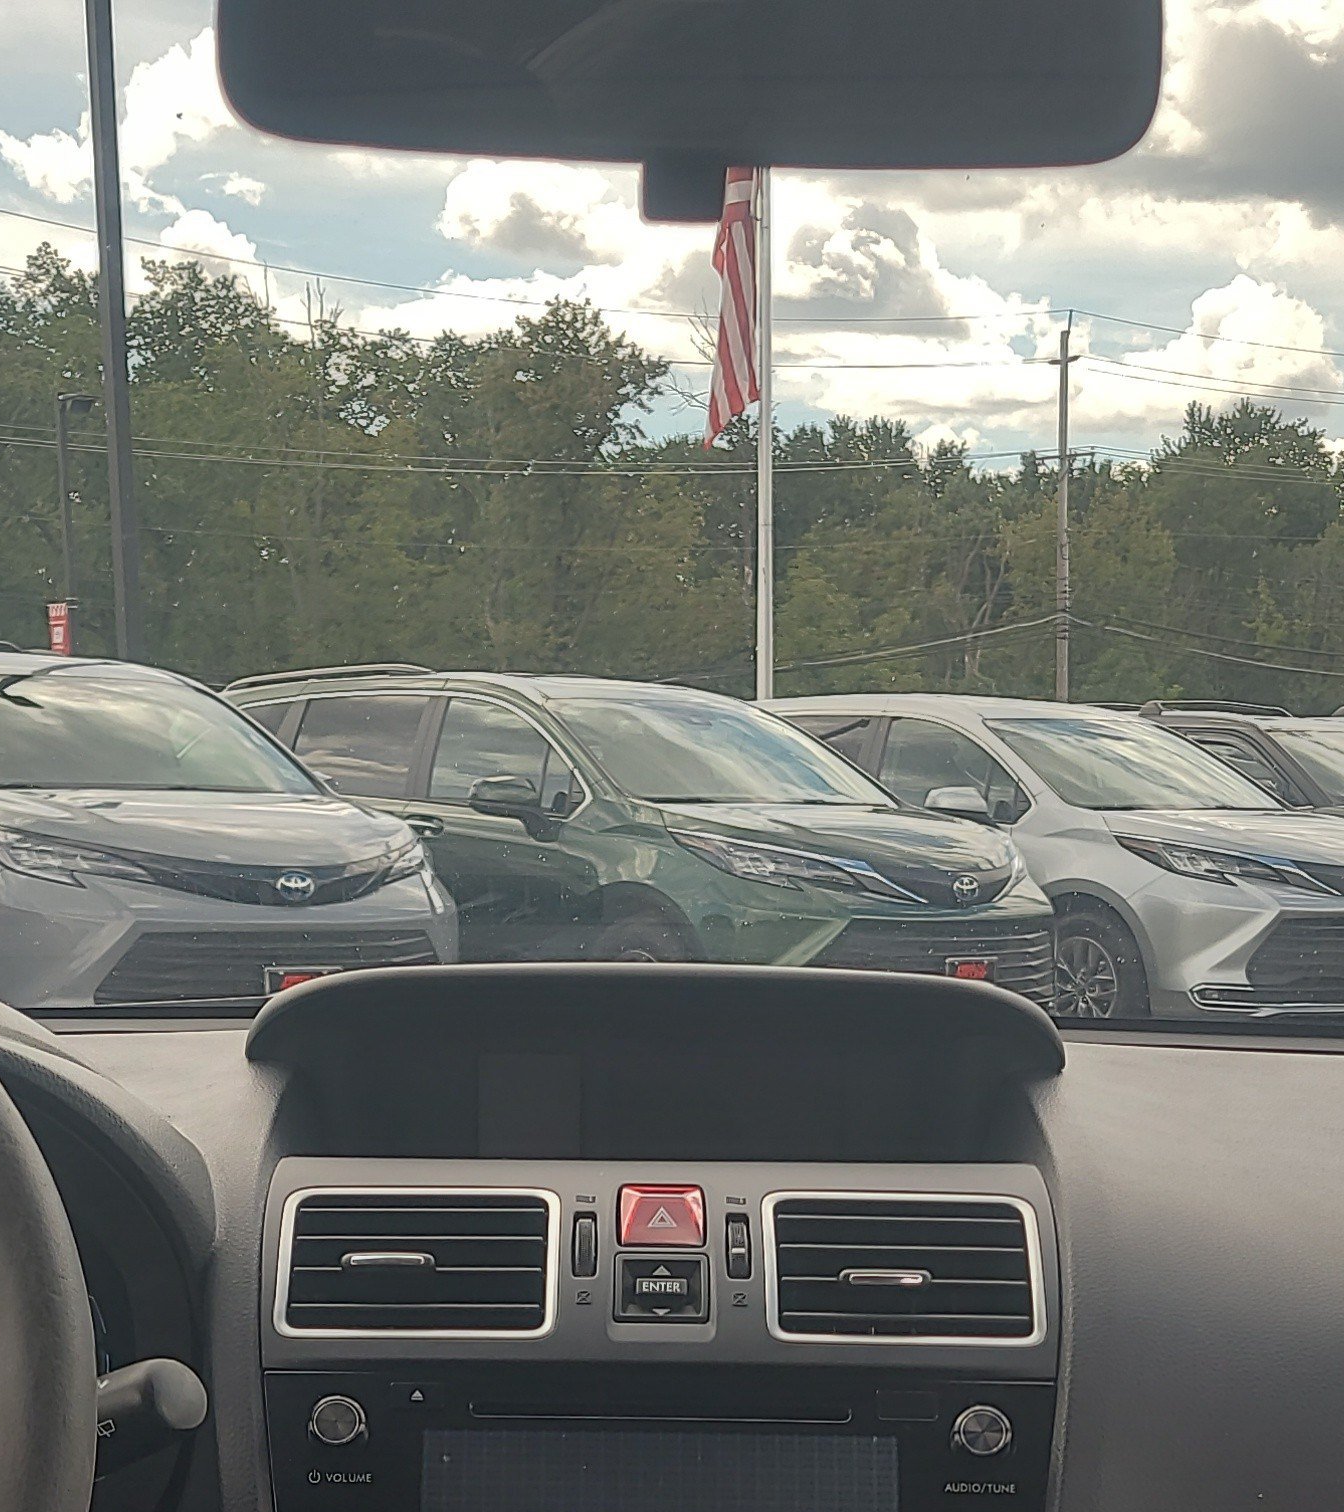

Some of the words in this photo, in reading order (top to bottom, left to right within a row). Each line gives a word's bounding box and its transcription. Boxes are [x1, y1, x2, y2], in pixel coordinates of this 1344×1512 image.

[642, 1281, 681, 1292] ENTER
[325, 1472, 372, 1483] VOLUME
[944, 1482, 1016, 1495] AUDIO/TUNE
